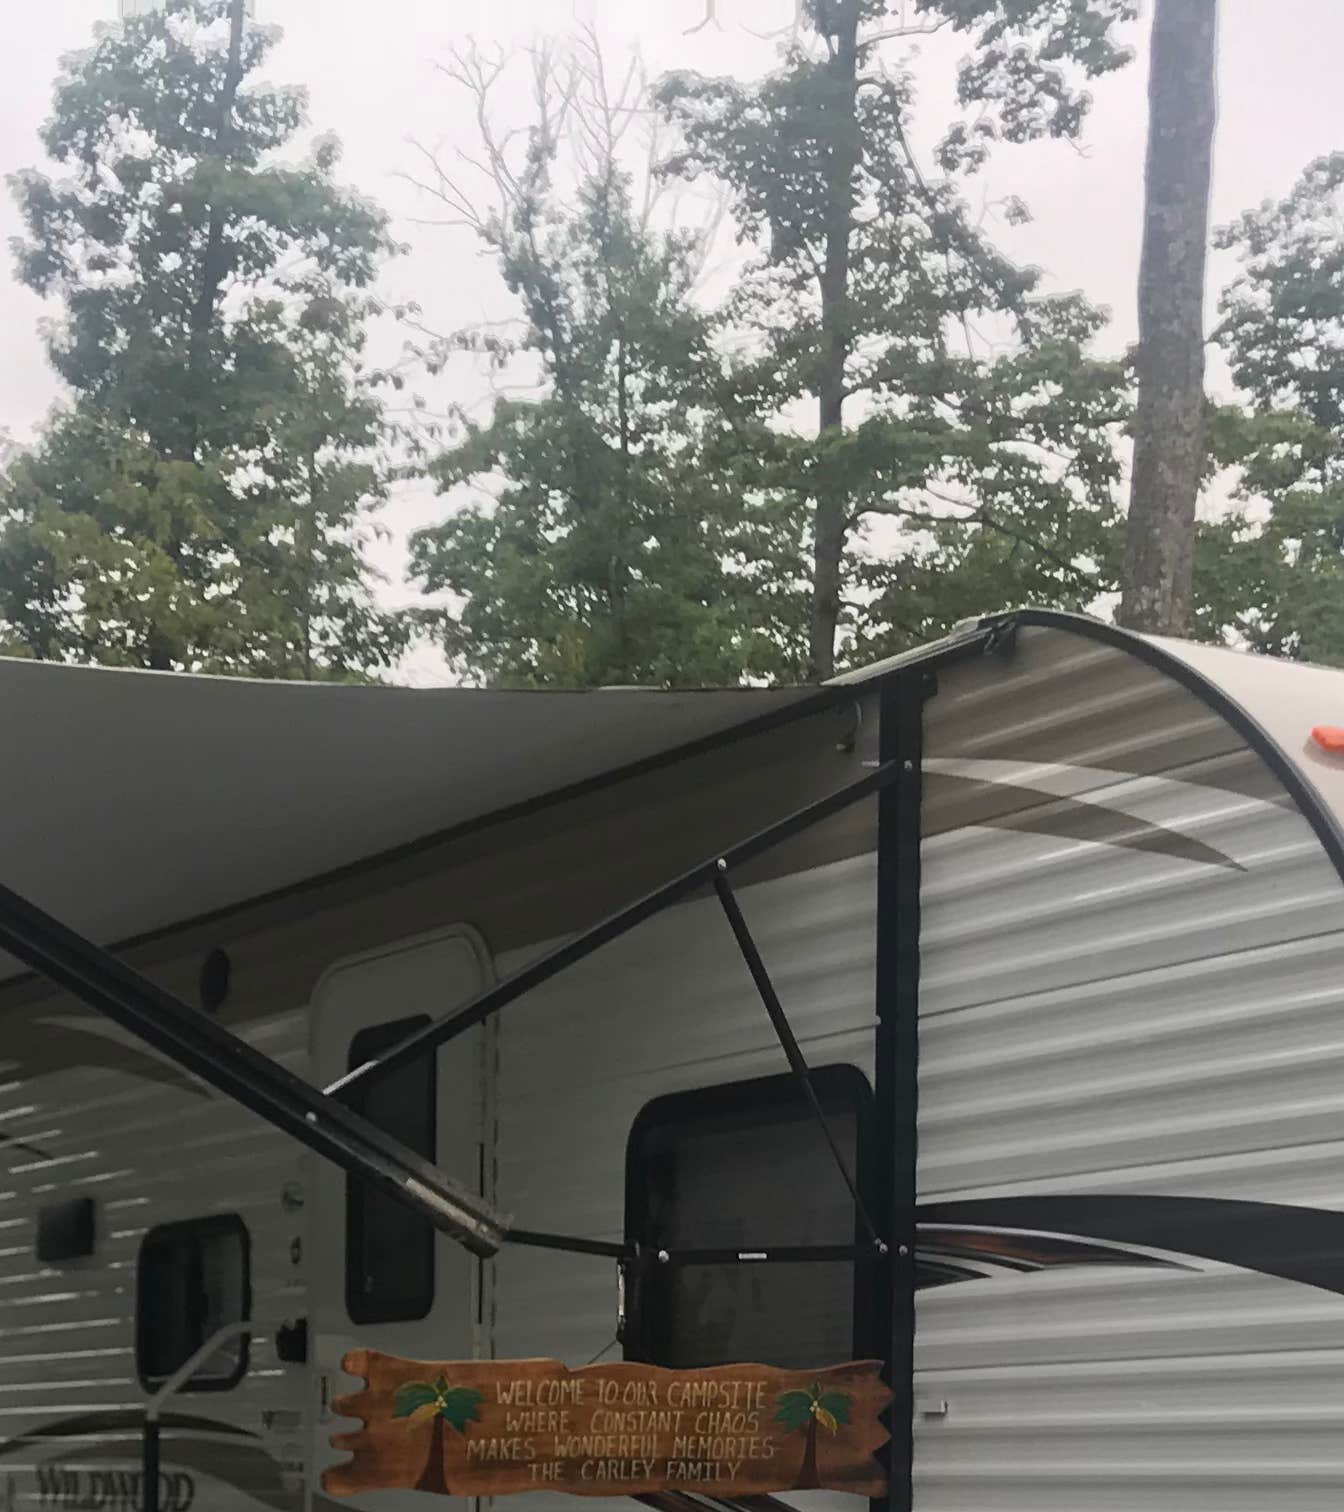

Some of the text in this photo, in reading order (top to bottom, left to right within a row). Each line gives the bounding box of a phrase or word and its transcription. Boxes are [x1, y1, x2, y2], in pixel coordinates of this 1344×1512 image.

[496, 1378, 769, 1410] WELCOME TO OUR CAMPSITE
[505, 1409, 760, 1435] WHERE CONSTANT CHAOS
[465, 1434, 776, 1462] MAKES WONDERFUL MEMORIES
[528, 1459, 742, 1483] THE CARLEY FAMILY
